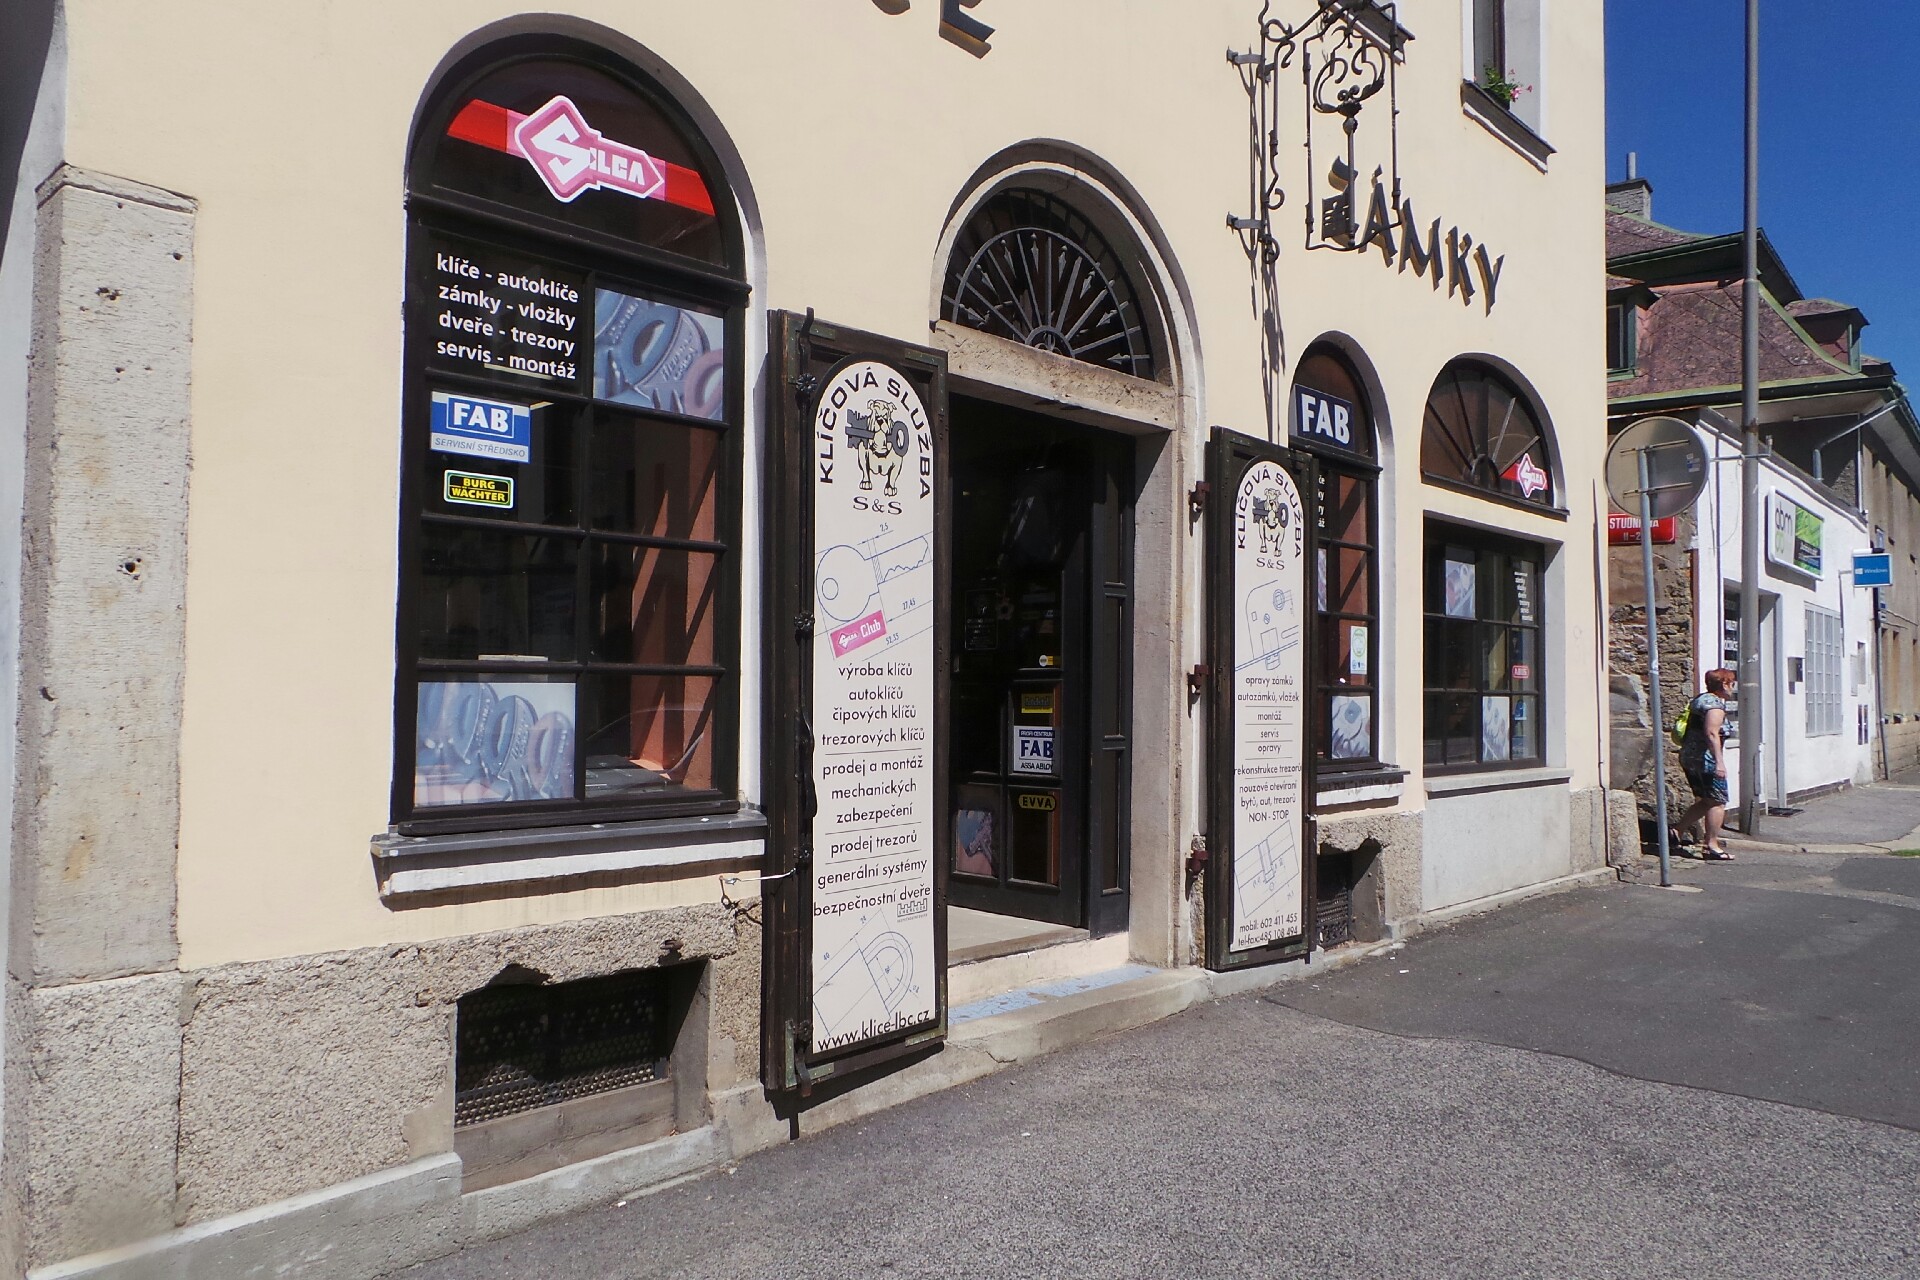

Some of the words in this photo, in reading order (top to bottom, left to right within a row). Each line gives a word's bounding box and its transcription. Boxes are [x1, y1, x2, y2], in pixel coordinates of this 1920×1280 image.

[530, 113, 646, 186] SILCA
[437, 253, 480, 279] klíče
[497, 272, 578, 303] autoklíče
[438, 284, 501, 314] zámky
[518, 302, 576, 330] vložky
[439, 310, 494, 336] dveře
[510, 326, 575, 356] trezory
[437, 340, 491, 362] servis
[509, 355, 576, 380] montáž
[454, 402, 508, 432] FAB
[1301, 394, 1350, 444] FAB
[816, 366, 878, 484] KLÍČOVÁ
[887, 378, 933, 499] SLUŽBA
[434, 437, 476, 451] SERVISNÍ
[477, 444, 526, 458] STŘEDISKO
[463, 478, 496, 490] BURG
[452, 486, 506, 502] WÄCHTER
[1236, 465, 1270, 549] KLÍČOVÁ
[1275, 473, 1302, 558] SLUŽBA
[1609, 517, 1659, 529] STUDNIA
[860, 619, 881, 638] Club
[839, 662, 884, 680] výroba
[888, 662, 912, 676] klíčů
[1246, 677, 1270, 687] opravy
[1272, 675, 1294, 686] zámků
[849, 685, 903, 700] autoklíčů
[1279, 691, 1300, 702] vložek
[832, 705, 887, 724] čipových
[892, 704, 916, 718] klíčů
[1258, 711, 1282, 720] montáž
[822, 728, 896, 747] trezorových
[900, 727, 924, 741] klíčů
[1260, 728, 1279, 738] servis
[1020, 740, 1054, 758] FAB
[1258, 745, 1281, 754] opravy
[823, 759, 866, 780] prodej
[870, 763, 876, 772] a
[882, 755, 923, 771] montáž
[1235, 763, 1278, 775] rekonstrukce
[1279, 763, 1302, 772] trezorů
[832, 778, 916, 800] mechanických
[1240, 782, 1268, 793] nouzové
[1022, 796, 1052, 808] EVVA
[1274, 793, 1296, 804] trezorů
[836, 802, 912, 824] zabezpečení
[1249, 812, 1267, 822] NON
[1272, 810, 1290, 820] STOP
[831, 836, 872, 858] prodej
[876, 830, 917, 848] trezorů
[818, 864, 878, 889] generální
[882, 859, 928, 878] systémy
[814, 889, 896, 916] bezpečnostní
[900, 883, 930, 900] dveře
[1260, 918, 1272, 928] 602
[1286, 913, 1298, 924] 455
[1286, 926, 1298, 936] 494
[818, 1010, 930, 1051] www.klice-lbc.cz
